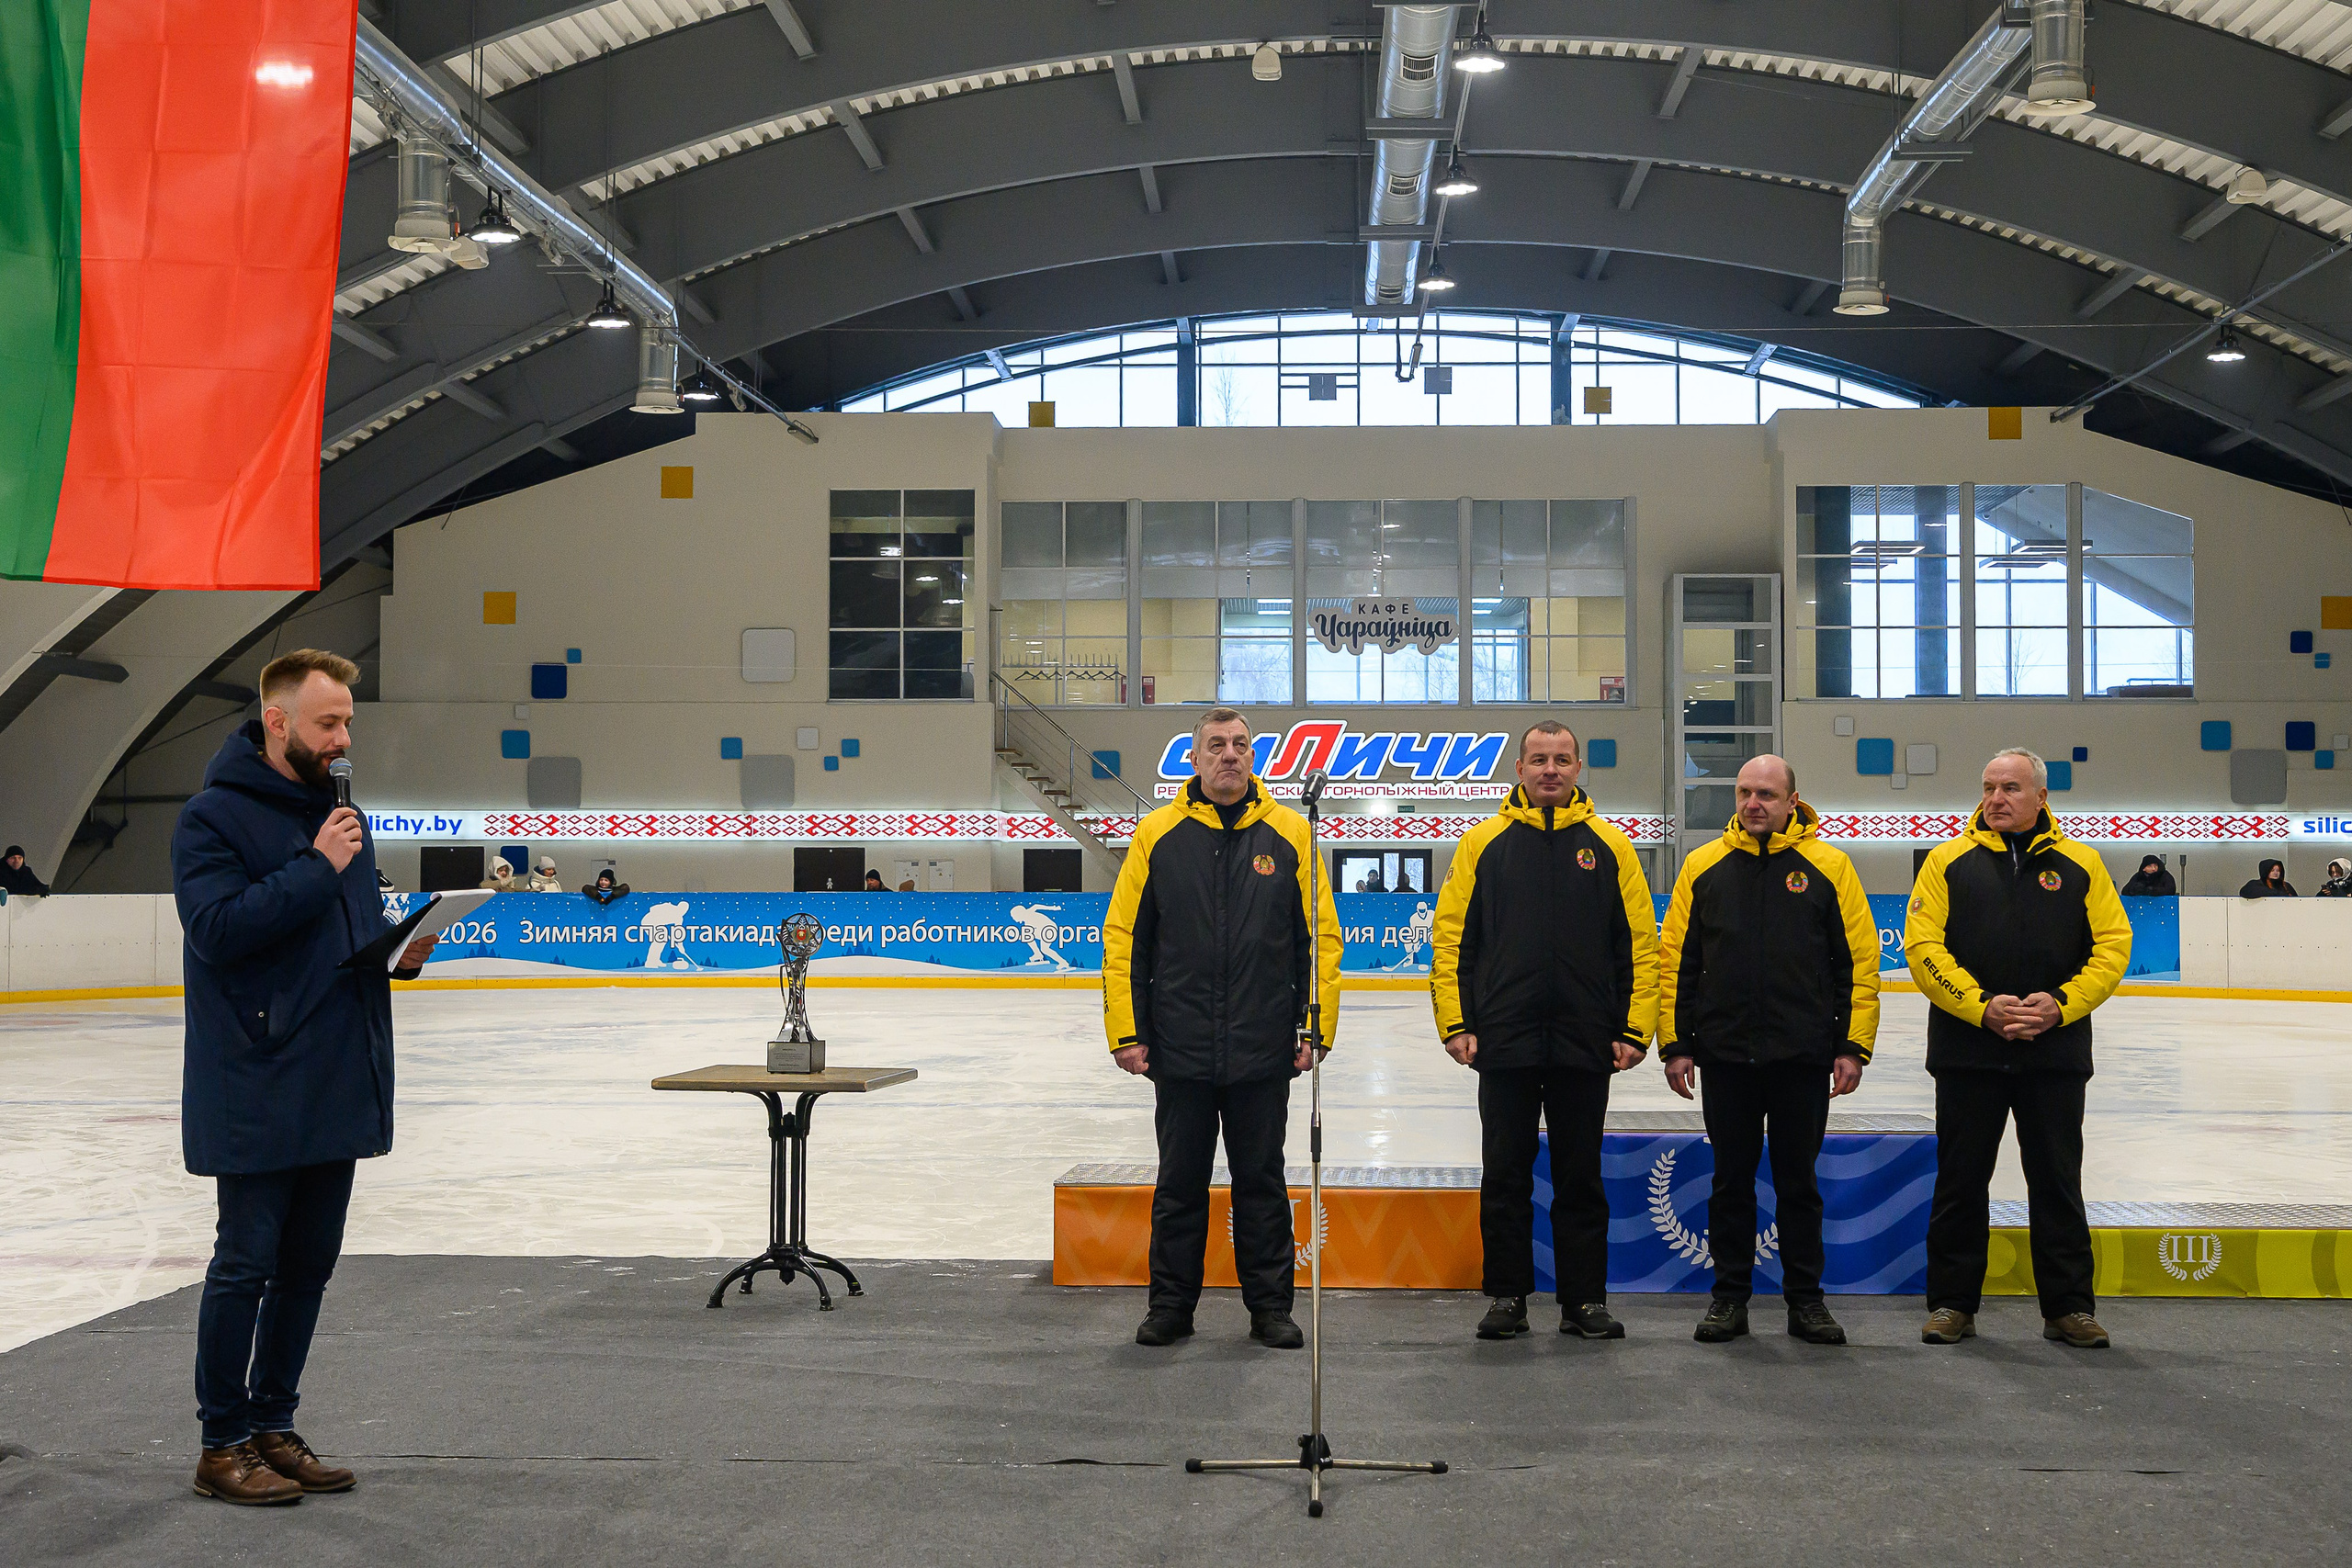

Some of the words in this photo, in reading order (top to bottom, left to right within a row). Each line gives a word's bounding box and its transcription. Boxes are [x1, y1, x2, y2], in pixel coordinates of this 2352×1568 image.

[1358, 603, 1410, 615] КАФЕ
[1315, 613, 1453, 649] Чараўніца
[1324, 784, 1454, 796] ГОРНОЛЫЖНЫЙ
[1458, 785, 1510, 798] ЦЕНТР
[368, 815, 464, 836] lichy.by
[437, 920, 499, 944] 2026
[518, 919, 617, 944] Зимняя
[880, 919, 1035, 949] работников
[1040, 924, 1104, 949] орга
[1922, 956, 1966, 1001] BELARUS
